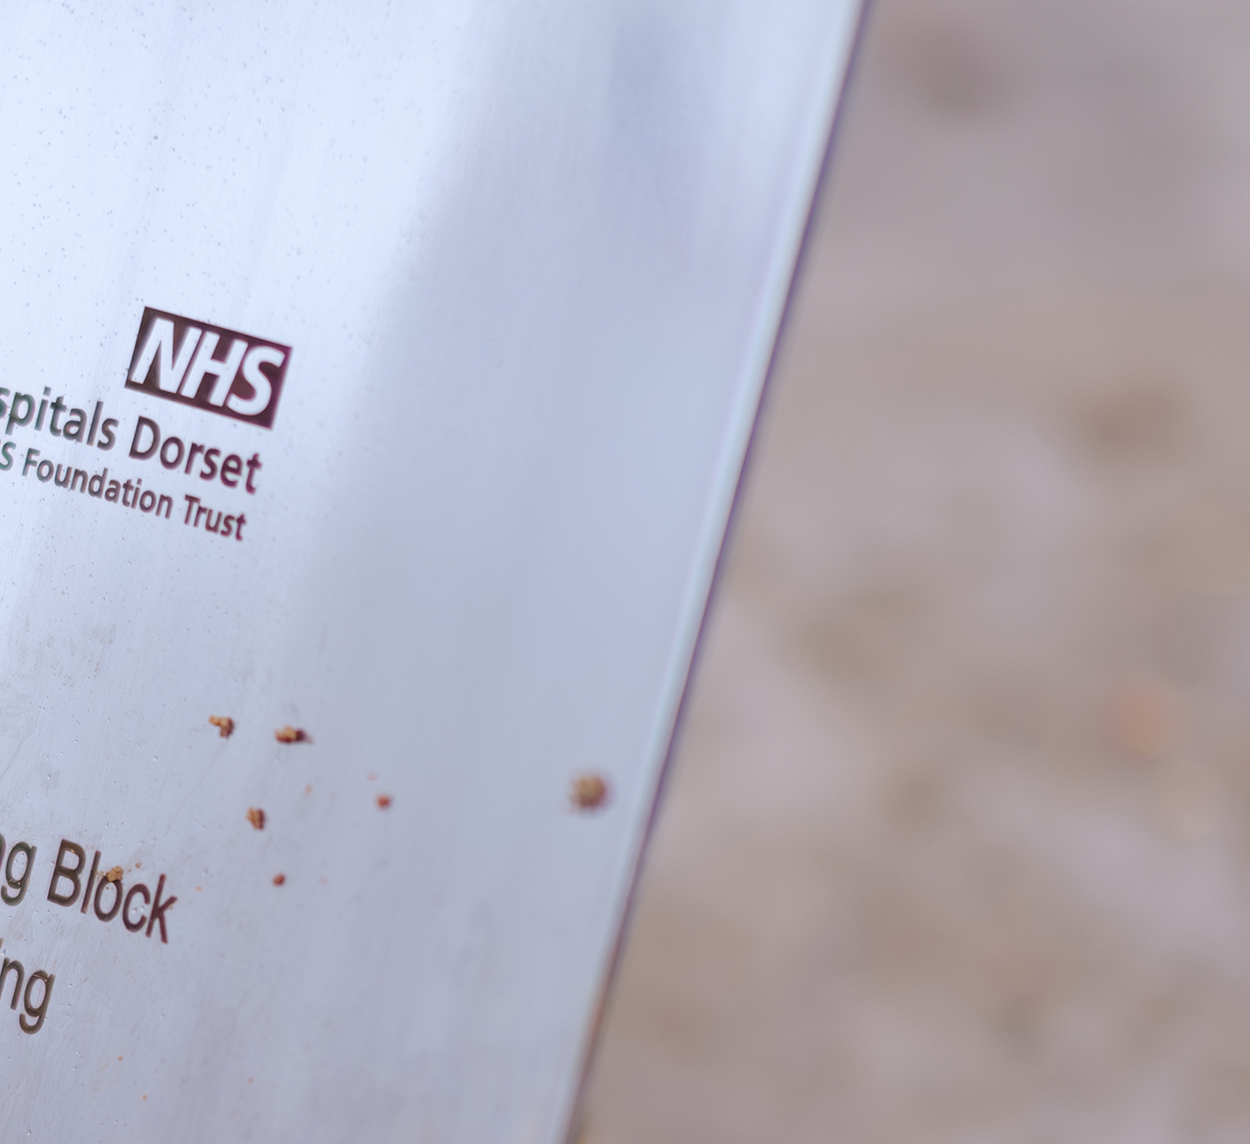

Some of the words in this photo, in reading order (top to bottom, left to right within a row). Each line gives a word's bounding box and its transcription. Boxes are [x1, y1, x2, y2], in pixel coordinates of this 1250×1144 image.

[131, 316, 286, 416] NHS
[22, 447, 174, 518] Foundation
[183, 493, 247, 542] Trust
[129, 416, 263, 495] Dorset
[46, 839, 178, 944] Block
